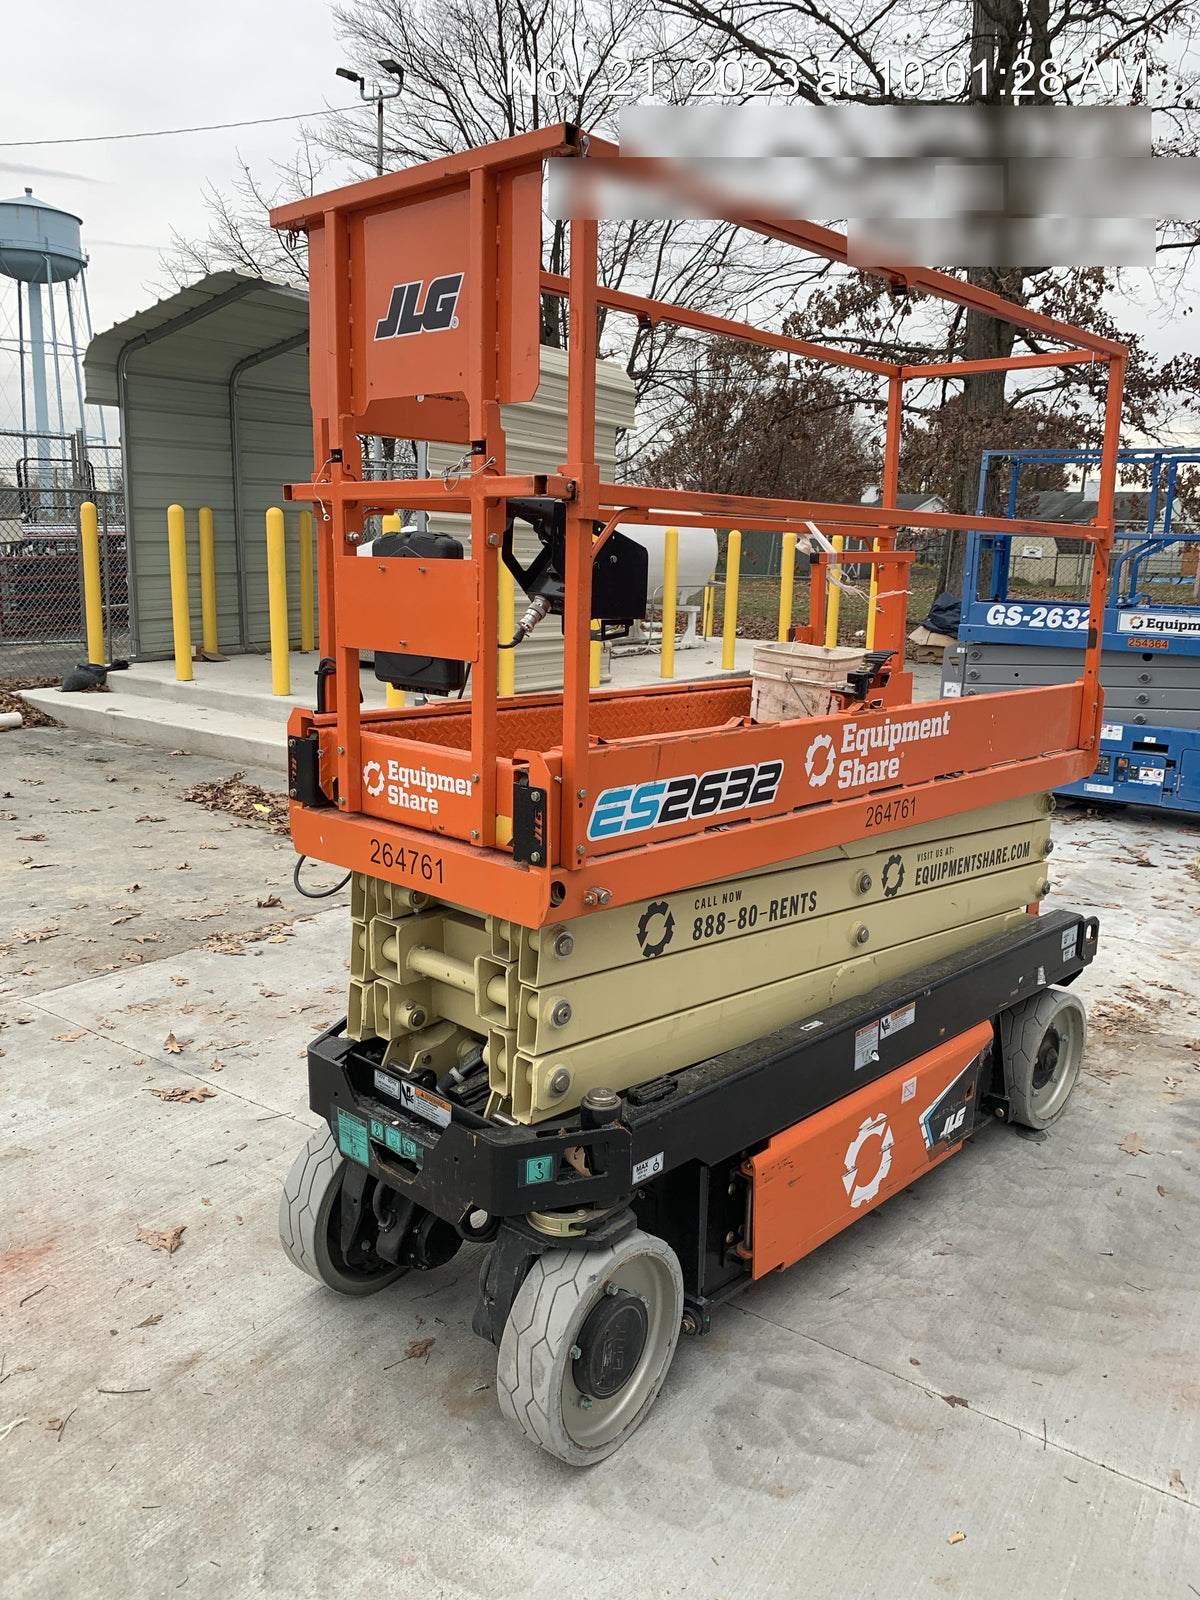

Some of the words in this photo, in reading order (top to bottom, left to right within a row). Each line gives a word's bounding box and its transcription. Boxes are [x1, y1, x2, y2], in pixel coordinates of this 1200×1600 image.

[986, 604, 1090, 630] GS-2632
[1129, 638, 1168, 648] 254364
[841, 711, 951, 756] Equipment
[837, 757, 900, 789] Share
[387, 785, 439, 815] Share
[588, 760, 783, 841] ES2632
[865, 798, 917, 828] 264761
[370, 838, 444, 883] 264761
[915, 841, 1031, 886] EQUIPMENTSHARE.COM
[917, 851, 933, 862] VISIT
[936, 849, 943, 858] US
[945, 846, 954, 855] AT:
[692, 890, 818, 941] 888-80-RENTS
[694, 895, 718, 910] CALL
[722, 889, 742, 904] NOW
[939, 1106, 967, 1139] JLG
